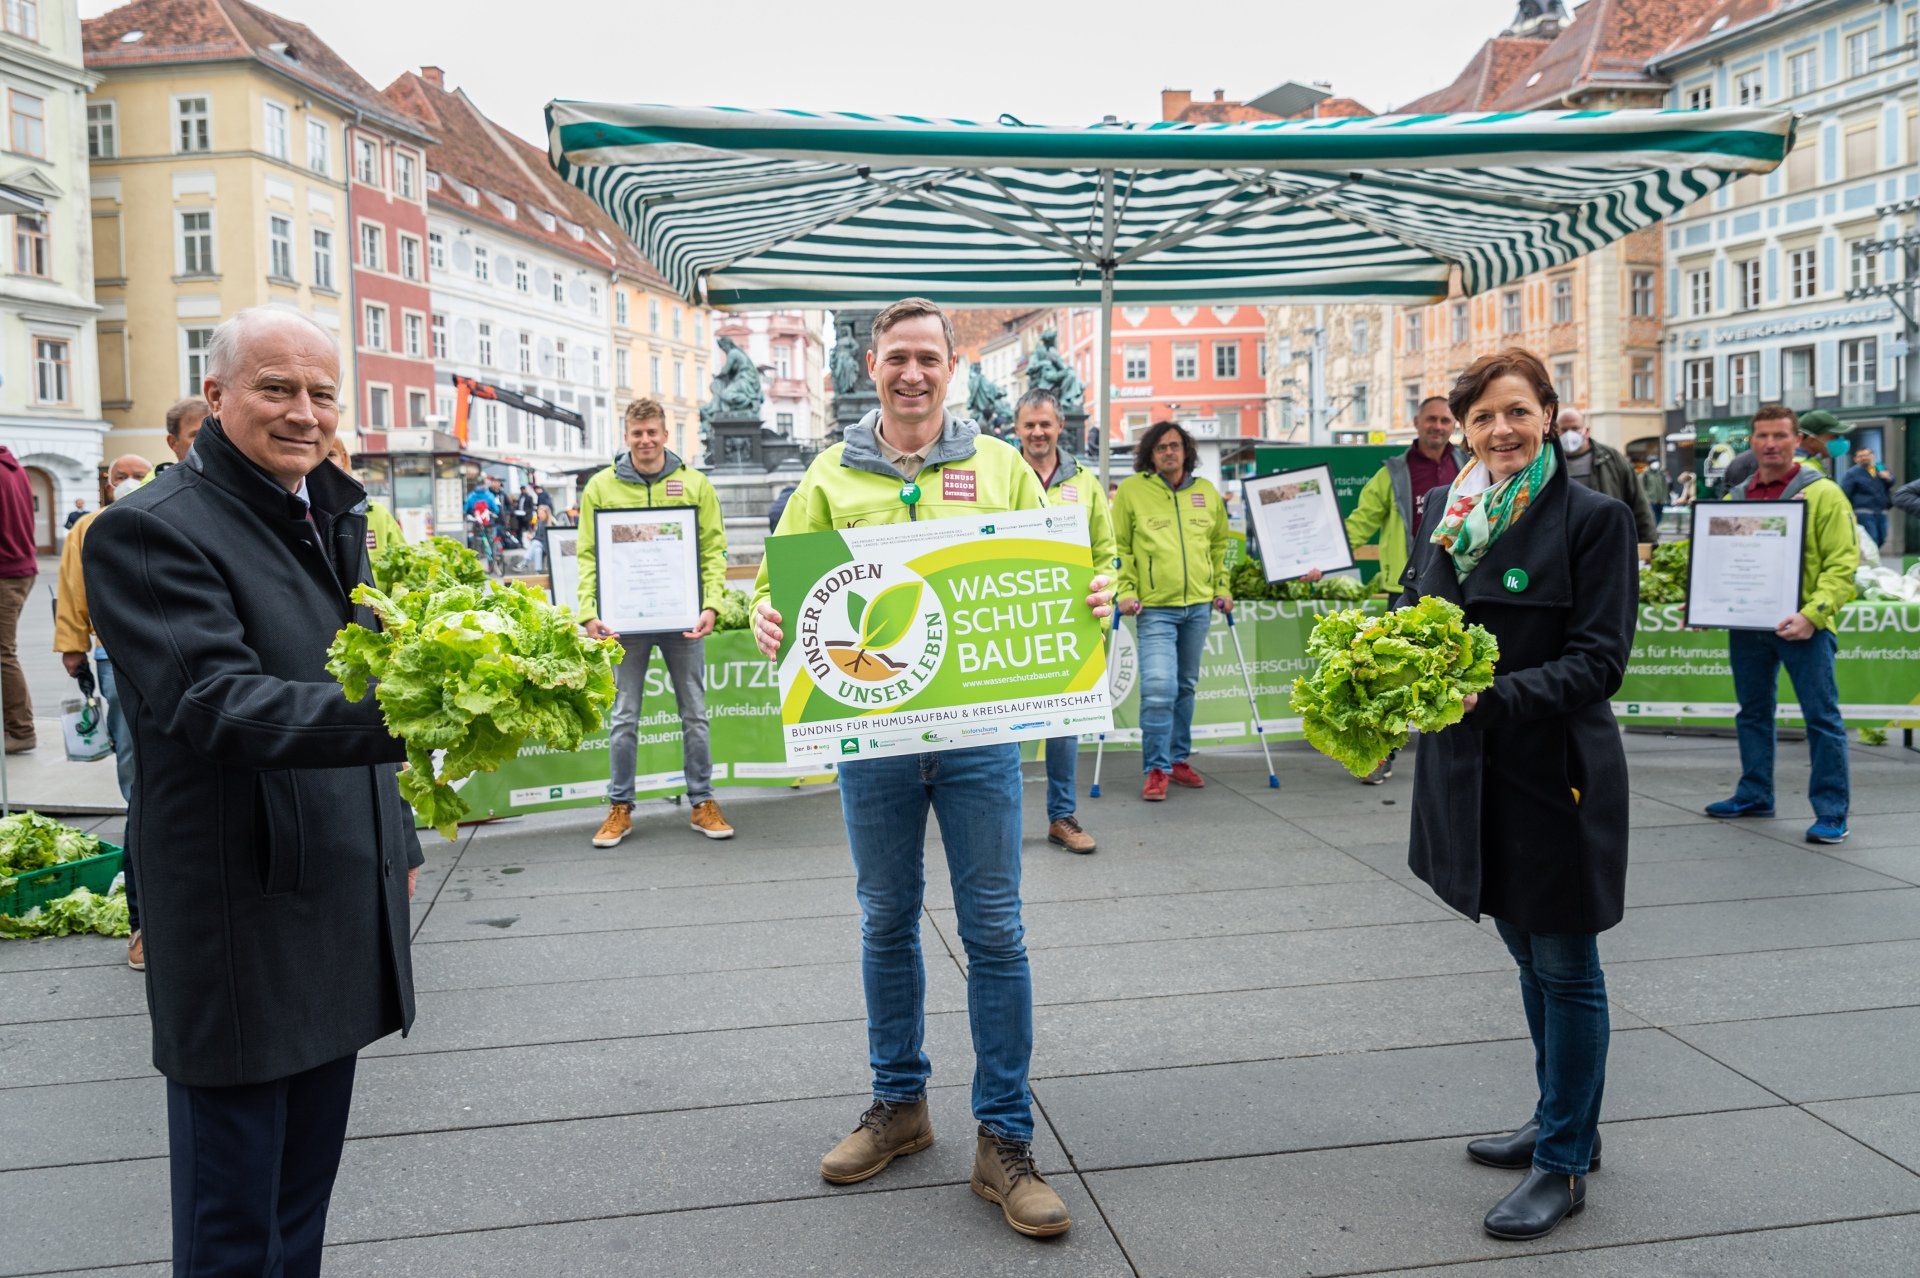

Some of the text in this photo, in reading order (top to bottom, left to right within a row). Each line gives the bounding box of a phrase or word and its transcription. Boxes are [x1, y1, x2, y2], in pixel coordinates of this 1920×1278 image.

[420, 436, 427, 447] 7
[1201, 423, 1215, 433] 15
[944, 473, 975, 482] GENUSS
[944, 481, 975, 490] REGION
[948, 566, 1071, 603] WASSER
[1506, 575, 1519, 589] lk
[802, 563, 883, 680] UNSER BODEN
[952, 598, 1075, 636] SCHUTZ
[838, 611, 943, 704] UNSER LEBEN
[957, 631, 1080, 674] BAUER
[962, 669, 1070, 688] www.wasserschutzbauern.at
[791, 693, 1103, 738] BÜNDNIS FÜR HUMUSAUFBAU & KREISLAUFWIRTSCHAFT
